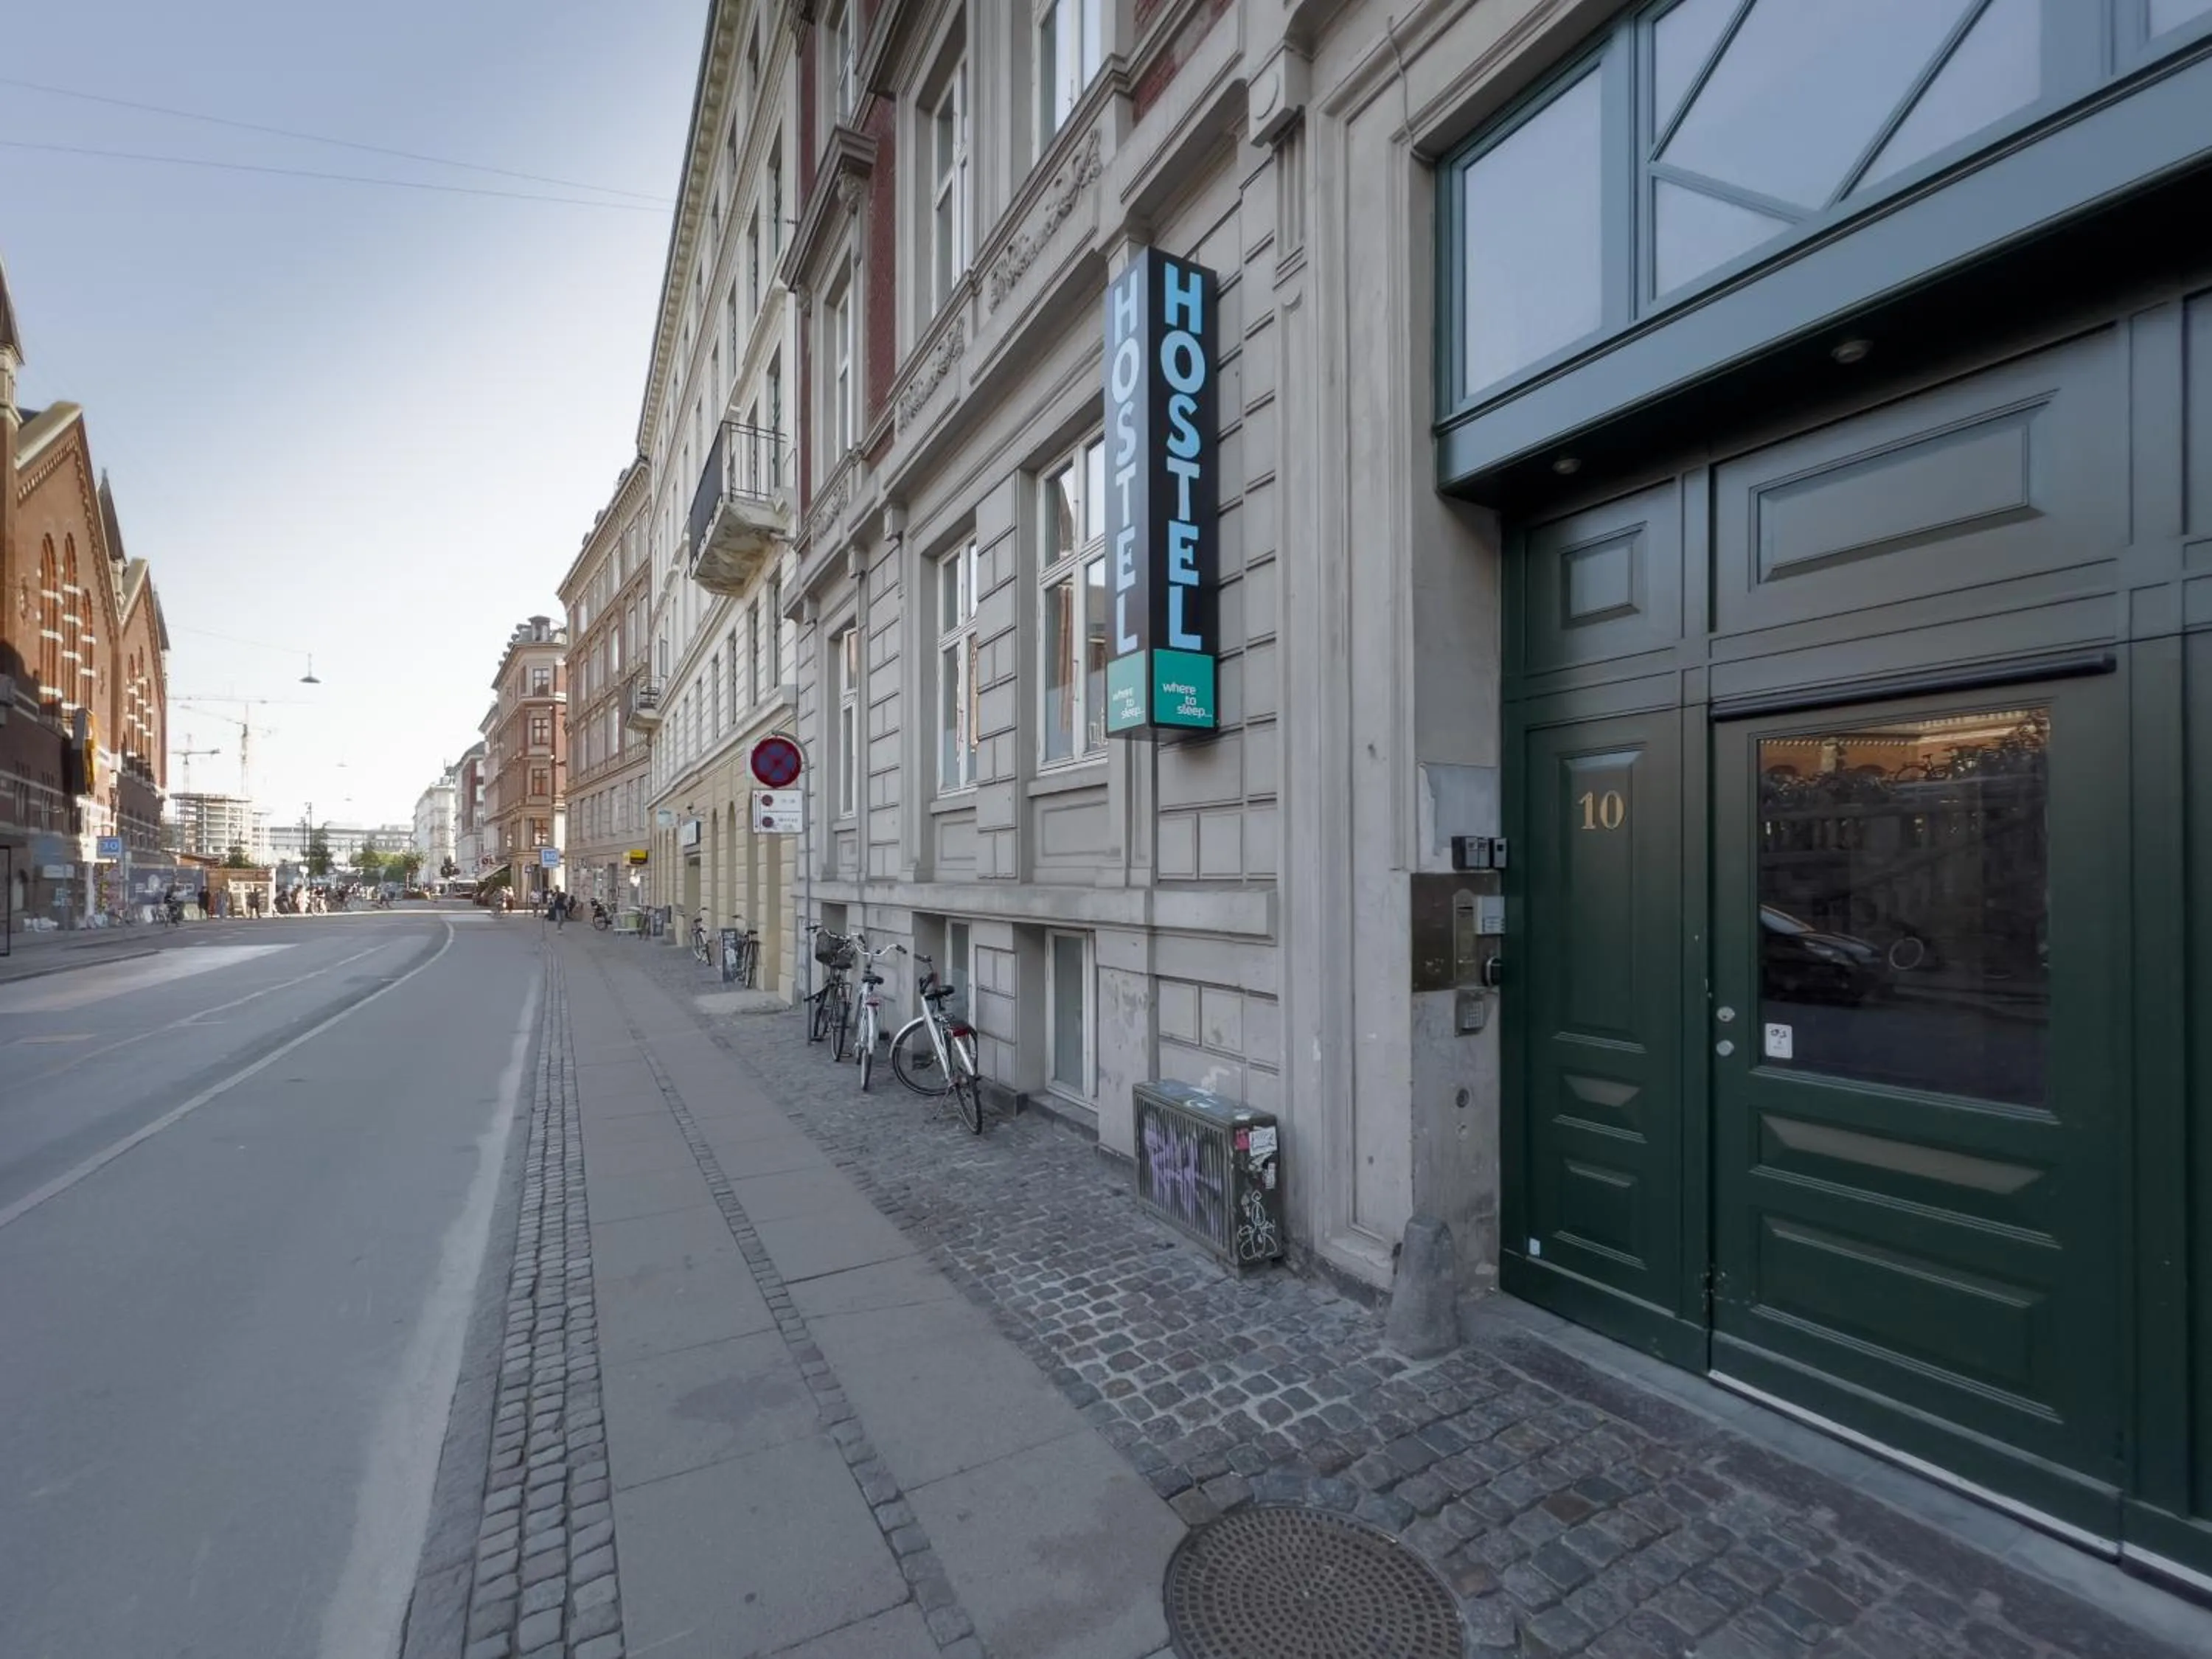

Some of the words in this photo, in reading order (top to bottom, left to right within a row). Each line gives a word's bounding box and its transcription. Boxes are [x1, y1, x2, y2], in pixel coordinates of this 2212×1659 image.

[1111, 270, 1140, 655] HOSTEL
[1160, 262, 1206, 651] HOSTEL
[1162, 681, 1197, 695] where
[1185, 695, 1197, 706] to
[1578, 790, 1624, 830] 10
